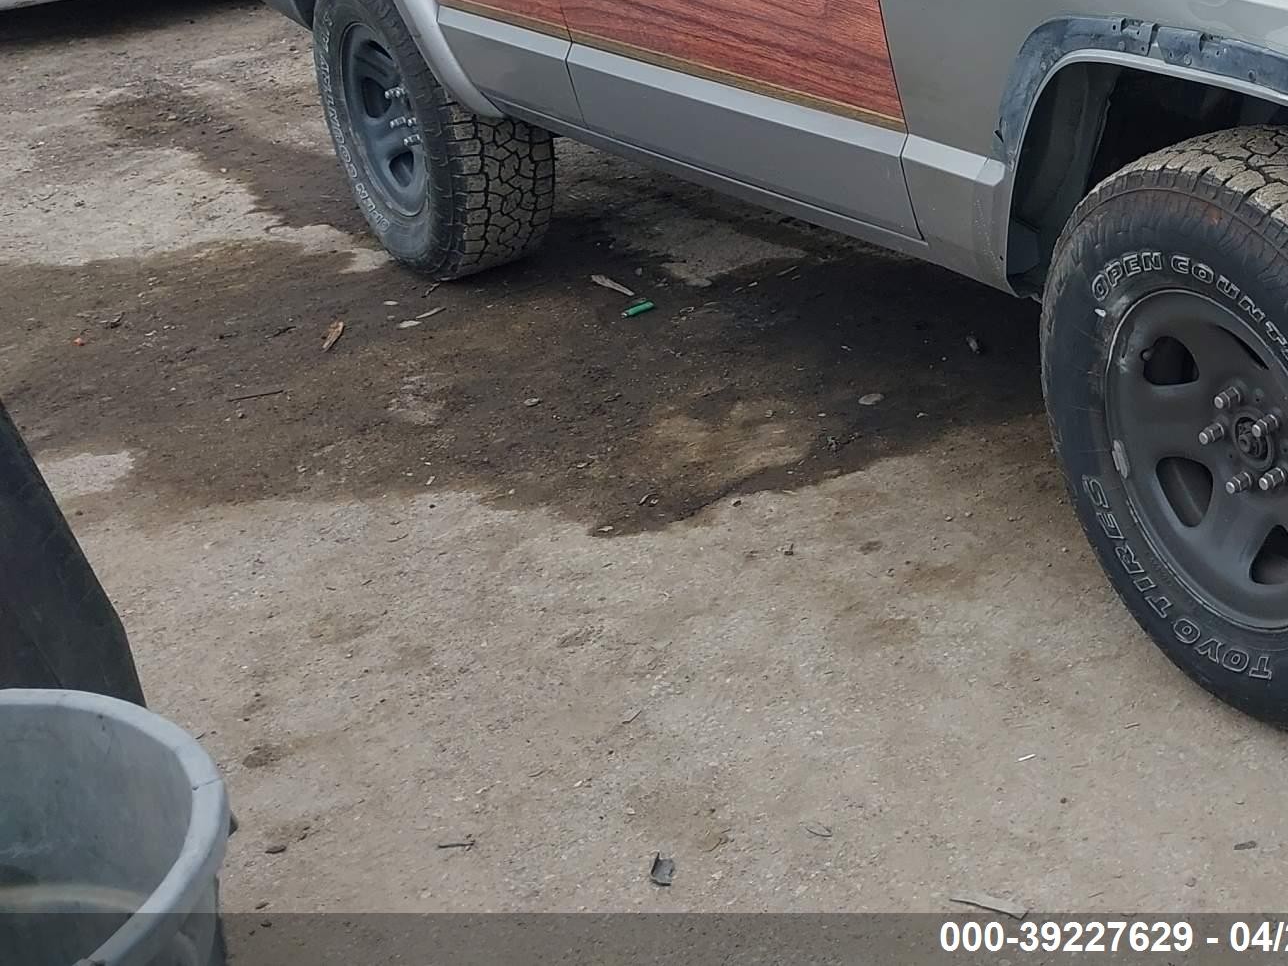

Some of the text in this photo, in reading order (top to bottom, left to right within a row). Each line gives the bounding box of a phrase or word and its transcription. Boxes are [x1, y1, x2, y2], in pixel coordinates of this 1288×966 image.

[1091, 251, 1163, 301] OPEN
[1081, 474, 1272, 680] TOYO TIRES
